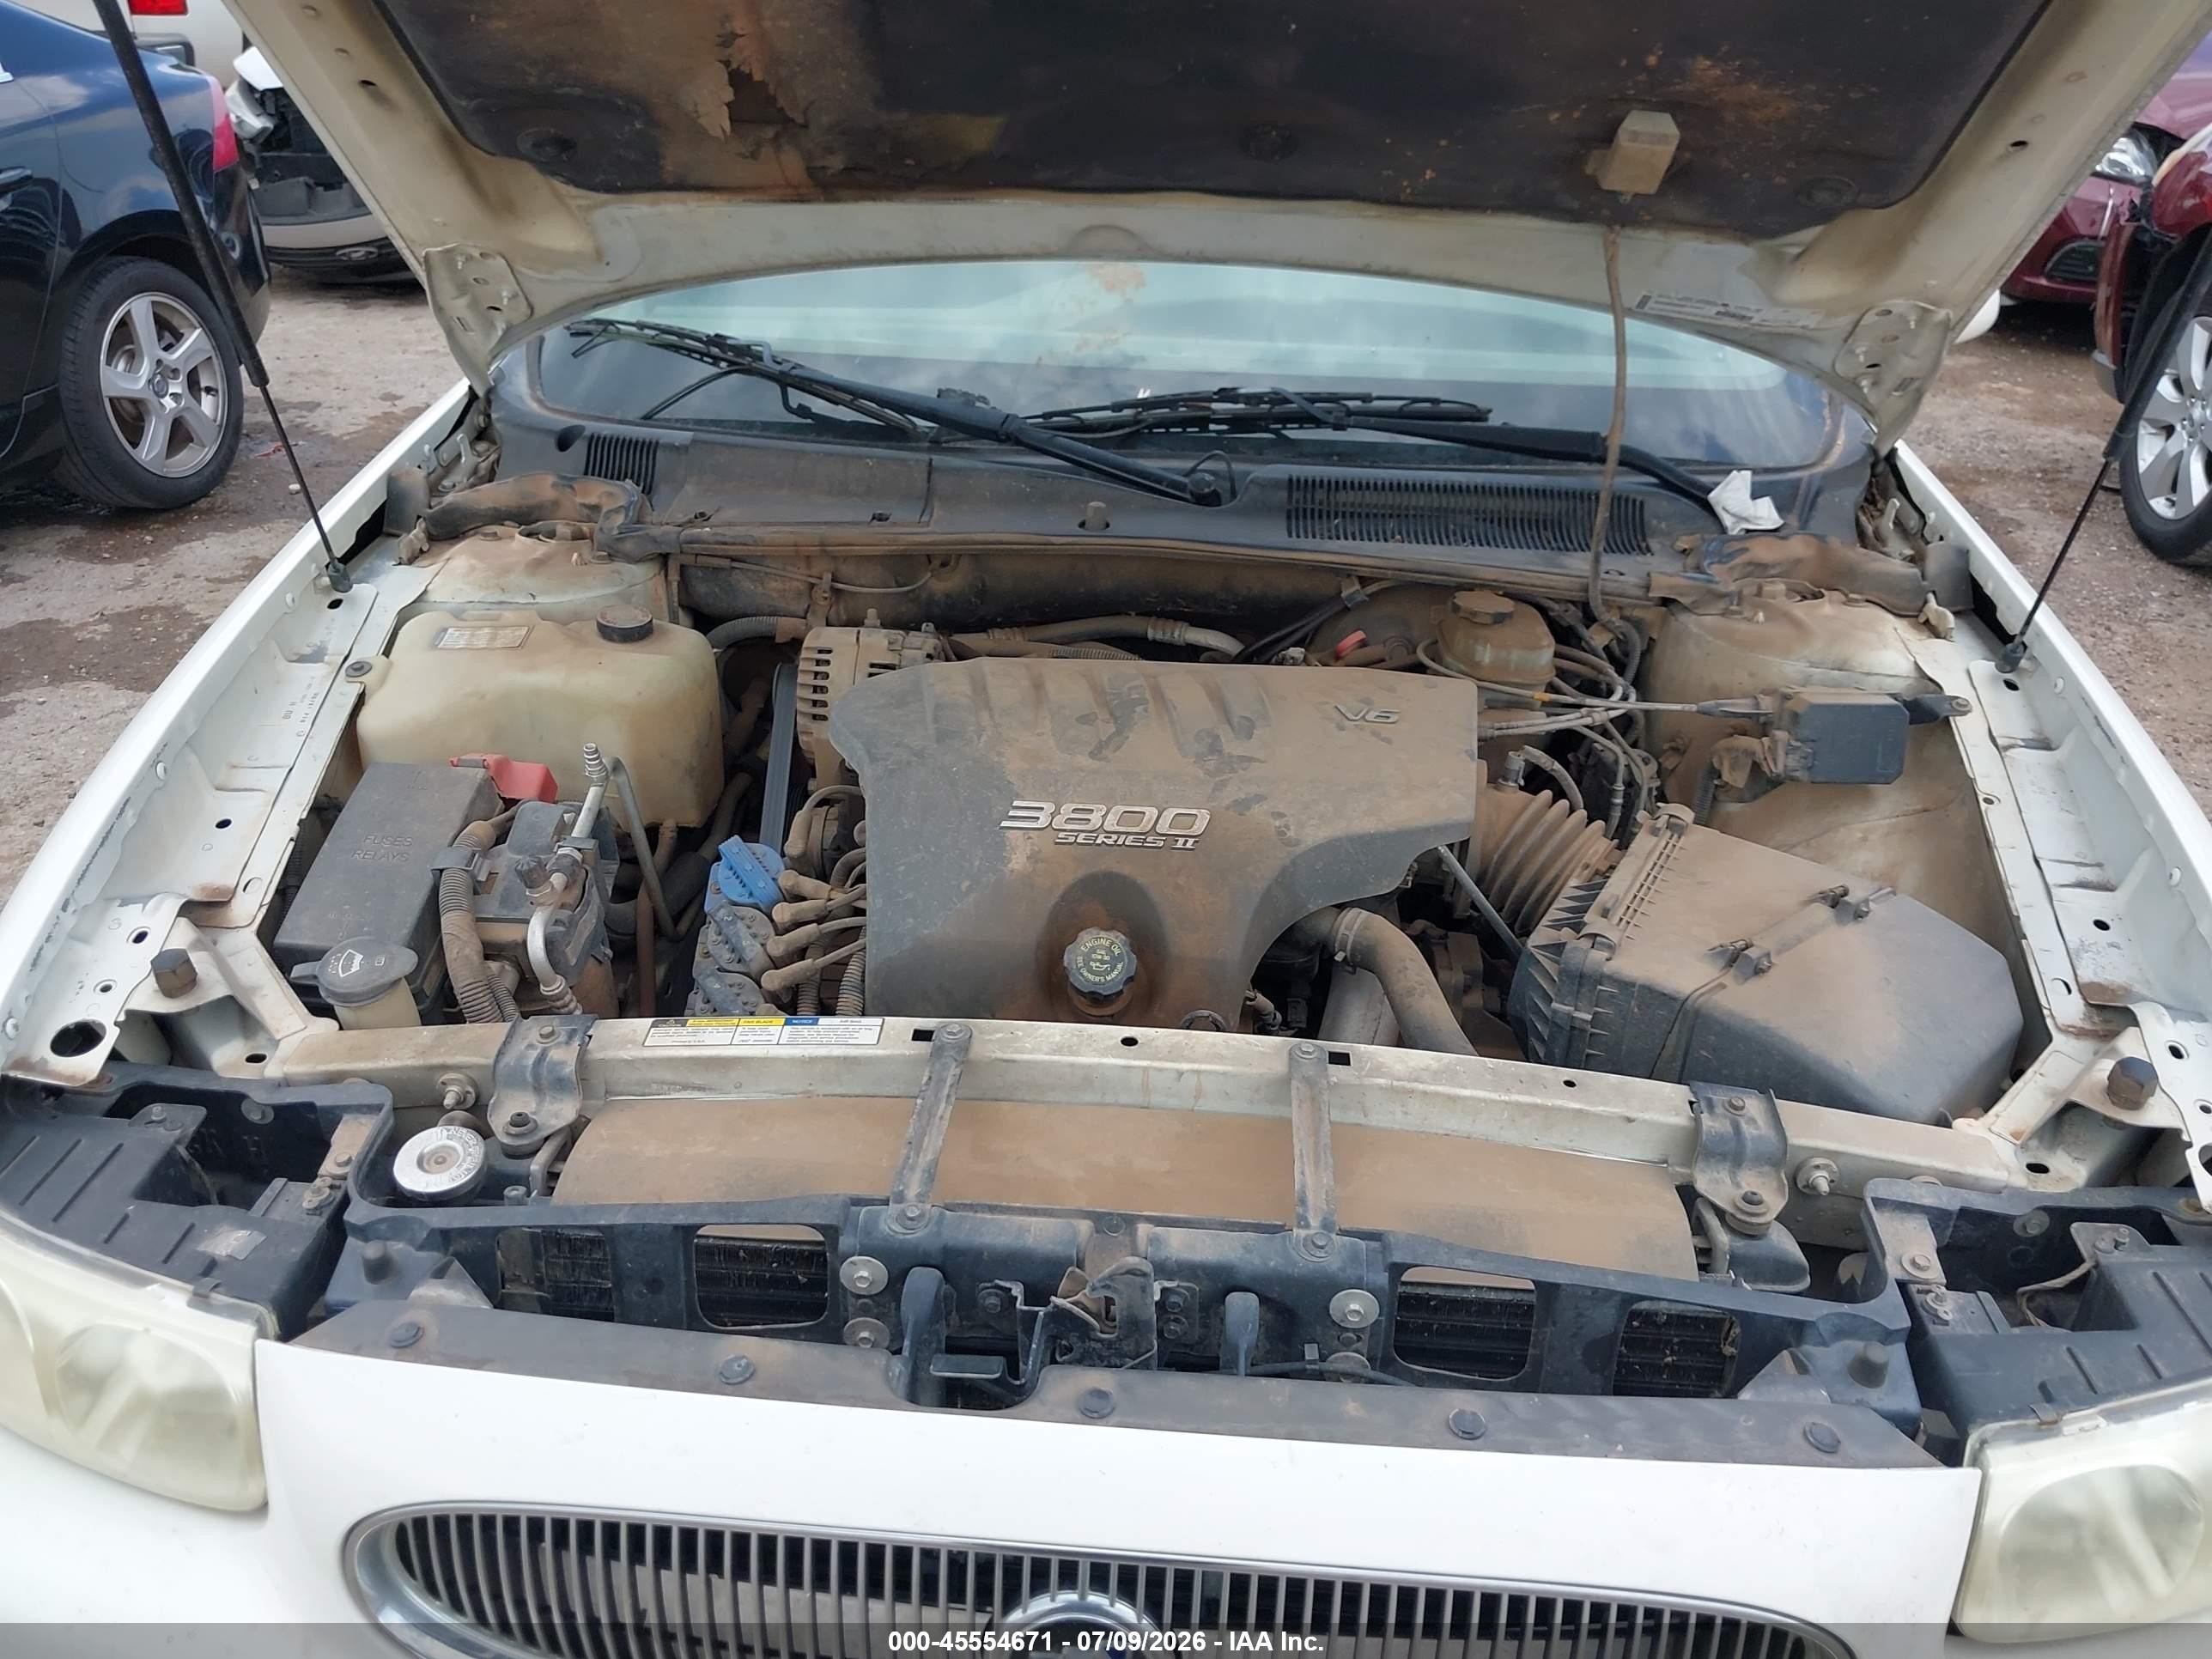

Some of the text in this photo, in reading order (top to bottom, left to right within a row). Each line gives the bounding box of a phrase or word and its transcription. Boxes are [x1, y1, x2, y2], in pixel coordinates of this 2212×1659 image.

[1334, 703, 1401, 725] V6
[999, 800, 1212, 836] 3800
[364, 835, 413, 847] FUSES
[1054, 832, 1200, 851] SERIES II
[351, 849, 410, 862] RELAYS
[1081, 939, 1121, 957] ENGINE OIL
